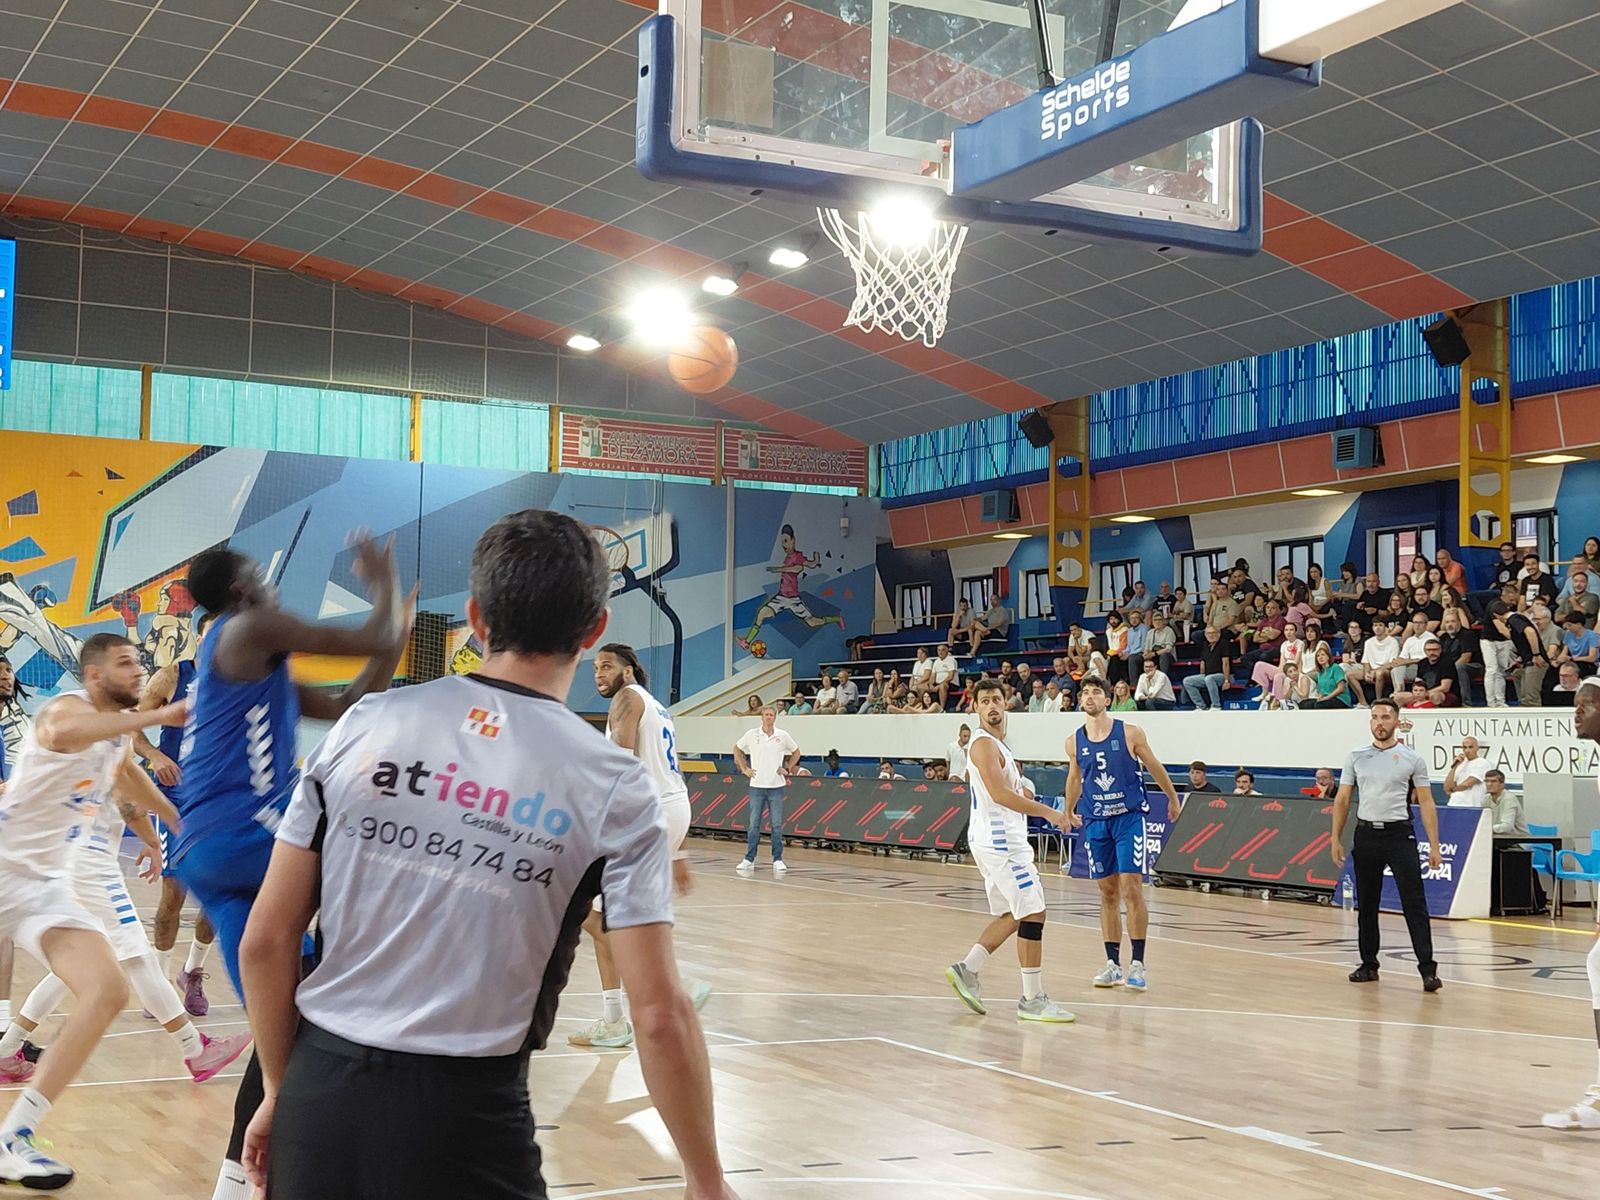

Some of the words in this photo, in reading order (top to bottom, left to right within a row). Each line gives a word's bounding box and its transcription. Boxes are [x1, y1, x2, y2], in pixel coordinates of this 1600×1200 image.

[1042, 61, 1130, 117] Schelde
[1041, 85, 1130, 140] Sports
[608, 431, 699, 449] AYUNTAMIENTO
[608, 443, 628, 460] DE
[631, 445, 699, 465] ZAMORA
[766, 455, 785, 470] DE
[788, 457, 849, 474] ZAMORA
[655, 467, 695, 476] DEPORTES
[1433, 718, 1571, 736] AYUNTAMIEN
[1095, 751, 1107, 770] 5
[372, 761, 572, 836] atiendo
[461, 812, 511, 836] Castilla
[512, 830, 524, 843] y
[527, 832, 565, 855] León
[360, 816, 418, 849] 900
[425, 832, 464, 862] 84
[470, 844, 506, 875] 74
[512, 858, 555, 889] 84
